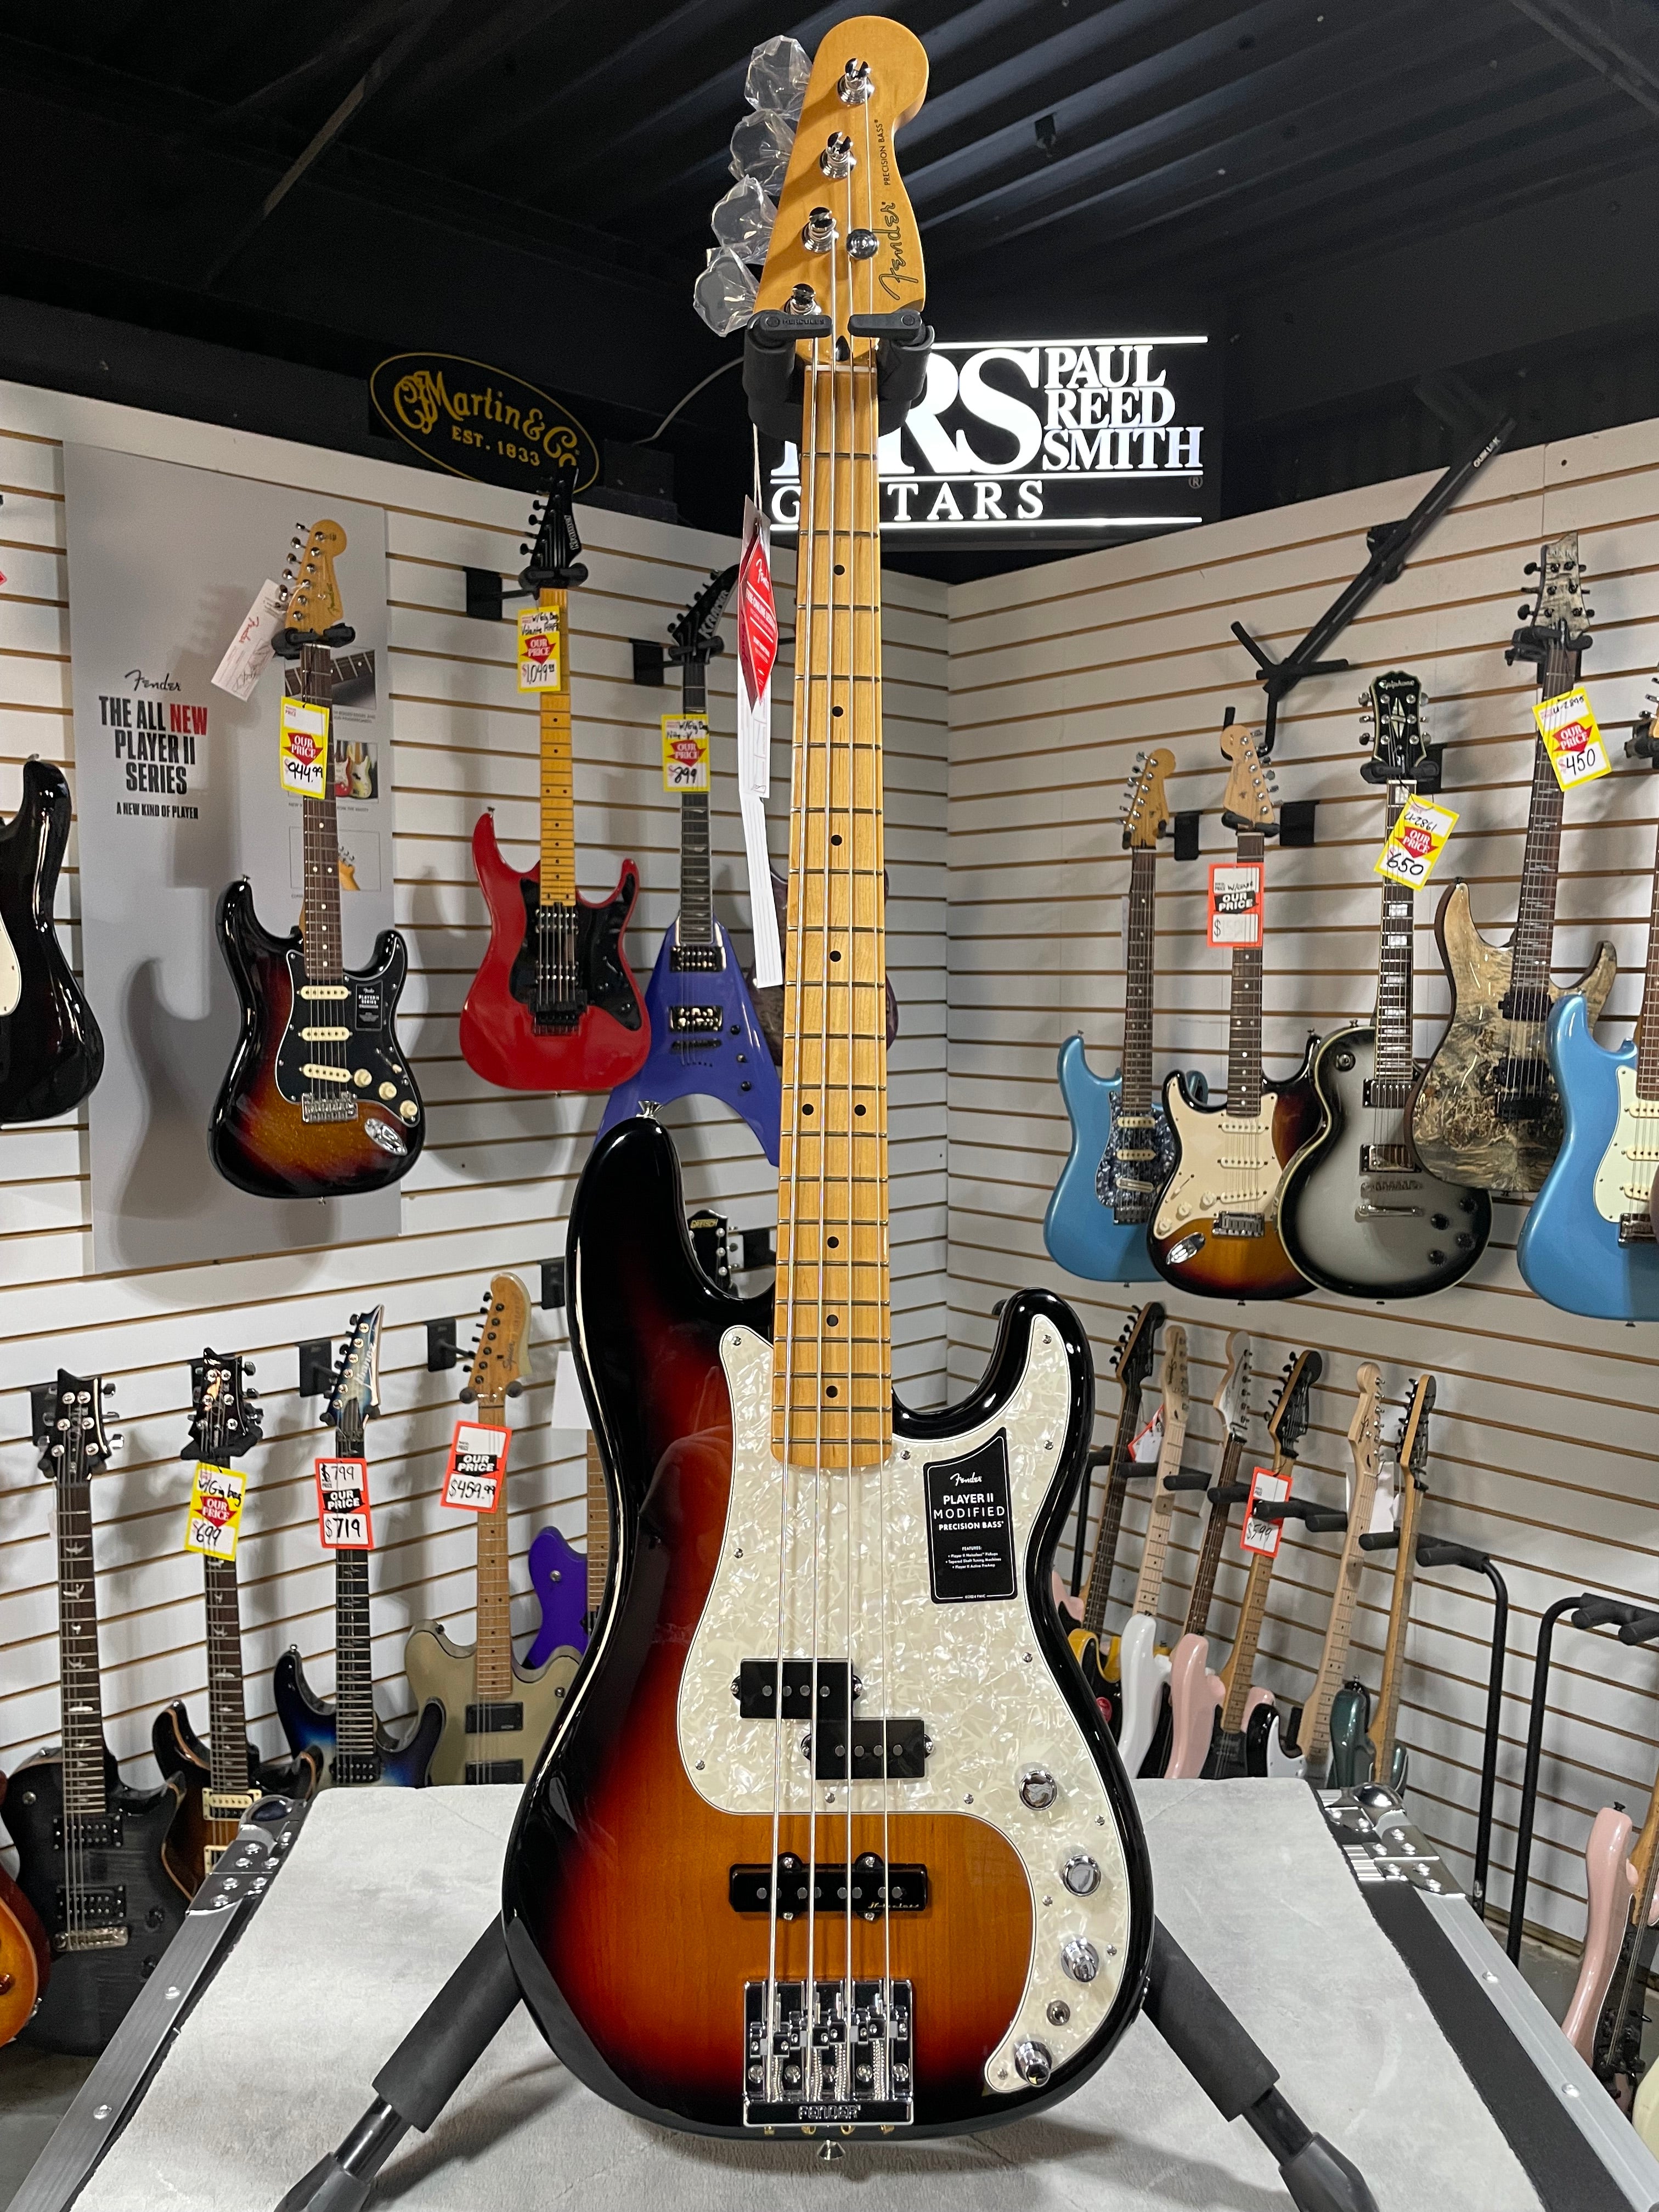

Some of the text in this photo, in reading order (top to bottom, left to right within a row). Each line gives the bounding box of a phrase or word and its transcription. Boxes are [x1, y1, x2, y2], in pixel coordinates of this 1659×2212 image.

[878, 146, 891, 186] PRECISION
[872, 202, 919, 301] Fender
[1045, 345, 1166, 389] PAUL
[771, 347, 1042, 474] RS
[1045, 386, 1176, 430] REED
[452, 425, 540, 466] EST. 1833
[1042, 426, 1204, 471] SMITH
[771, 480, 1043, 524] GTARS
[530, 639, 548, 648] OUR
[528, 647, 550, 657] PRICE
[124, 669, 182, 691] Fender
[99, 695, 207, 736] THE ALL NEW
[1560, 724, 1583, 740] OUR
[115, 729, 195, 765] PLAYER II
[294, 735, 313, 747] OUR
[676, 743, 696, 752] OUR
[1560, 733, 1589, 751] PRICE
[291, 744, 317, 759] PRICE
[675, 751, 699, 759] PRICE
[126, 761, 188, 795] SERIES
[116, 802, 198, 820] A NEW KIND OF PLAYER
[1402, 836, 1431, 854] PRICE
[1409, 830, 1431, 845] OUR
[1218, 899, 1254, 912] PRICE
[1222, 893, 1247, 903] OUR
[463, 1454, 490, 1463] OUR
[457, 1463, 495, 1472] PRICE
[950, 1471, 983, 1486] Fender
[330, 1490, 354, 1501] OUR
[943, 1492, 994, 1505] PLAYER II
[207, 1498, 228, 1511] OUR
[328, 1498, 360, 1510] PRICE
[202, 1508, 230, 1521] PRICE
[933, 1505, 1005, 1520] MODIFIED
[325, 1517, 361, 1539] $719
[938, 1522, 980, 1531] PRECISION
